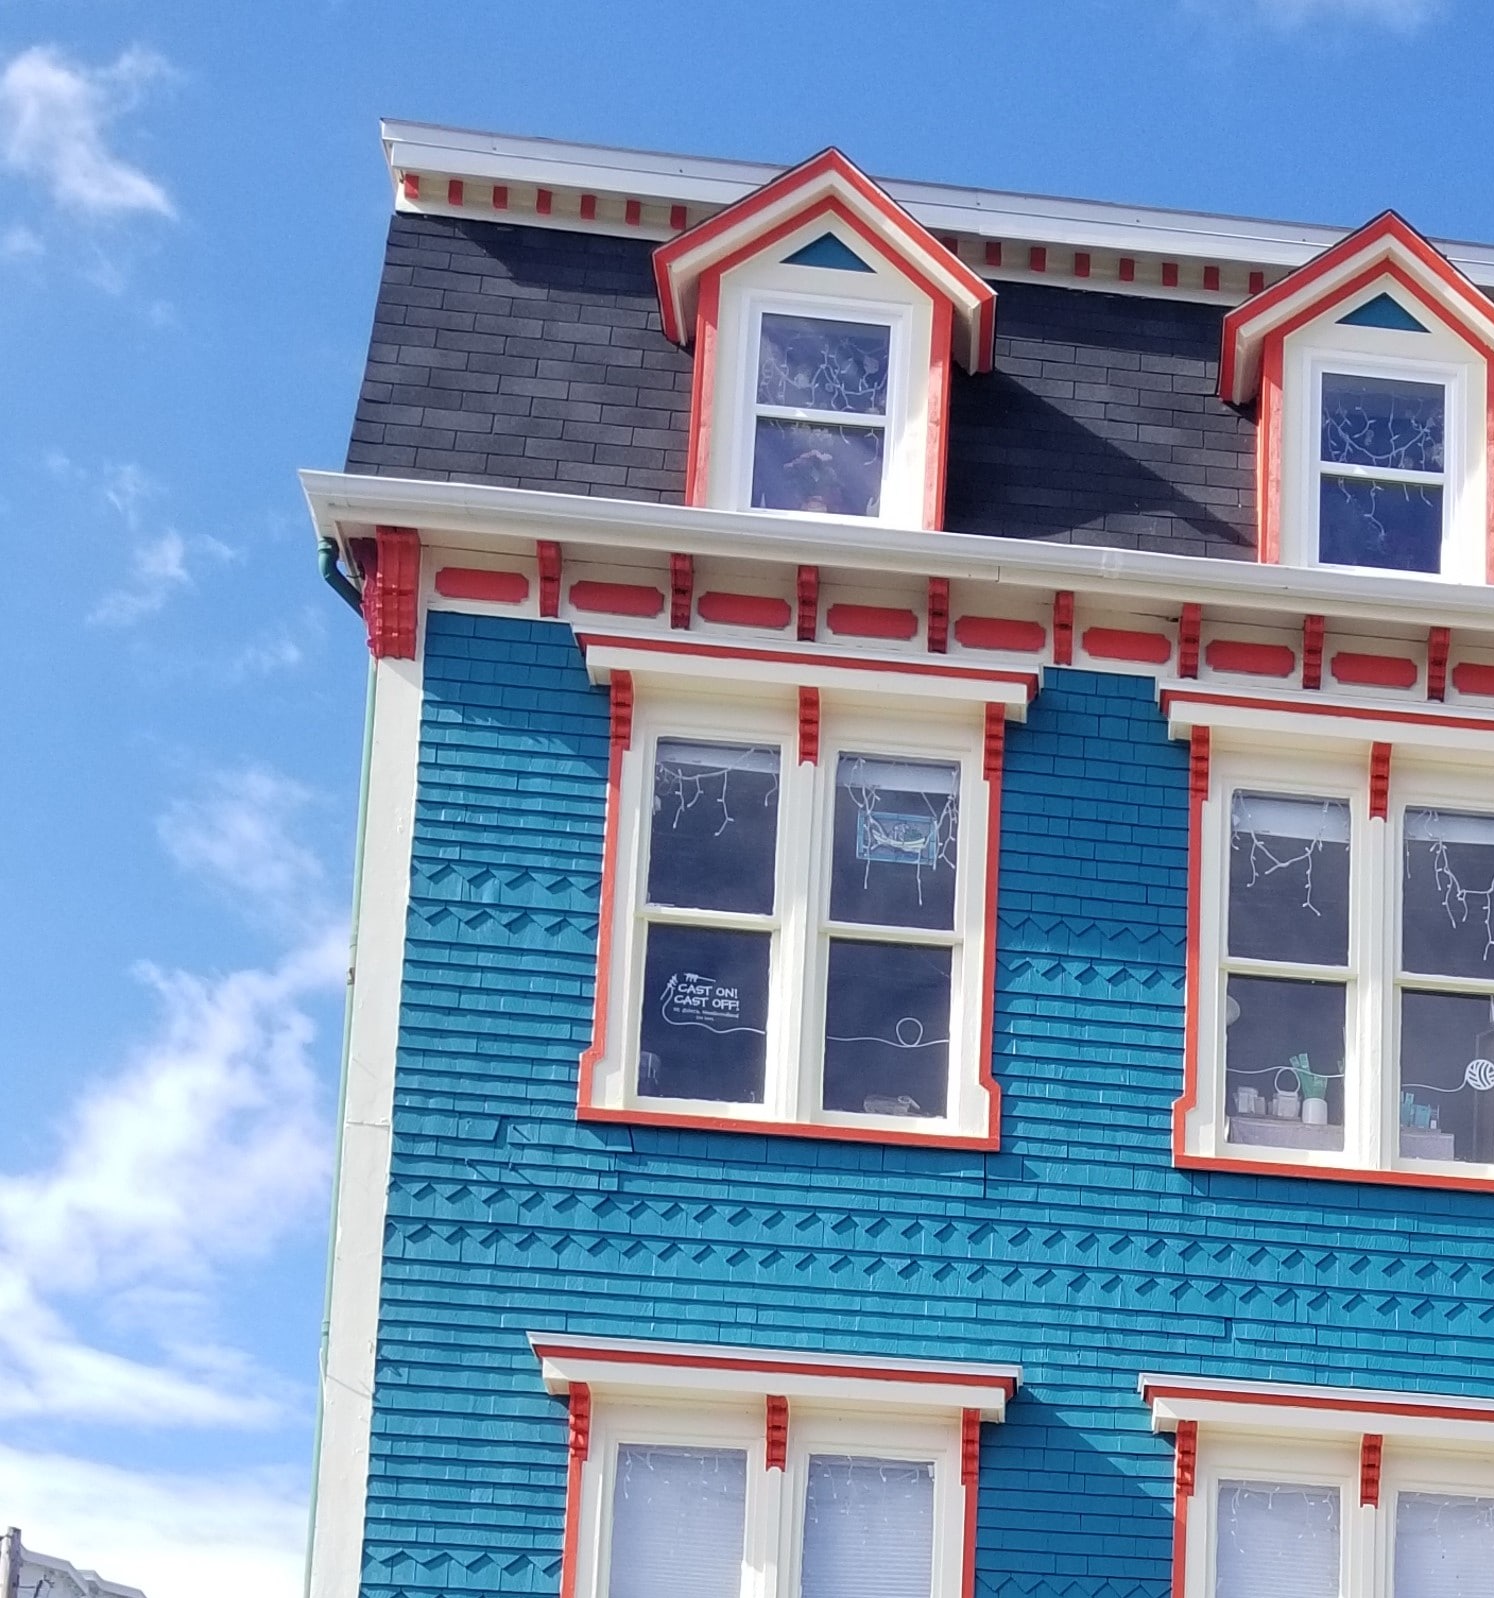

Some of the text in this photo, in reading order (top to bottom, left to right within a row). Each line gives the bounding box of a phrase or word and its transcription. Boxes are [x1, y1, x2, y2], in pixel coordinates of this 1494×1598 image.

[678, 983, 738, 999] CAST ON!
[674, 995, 740, 1011] CAST OFF!
